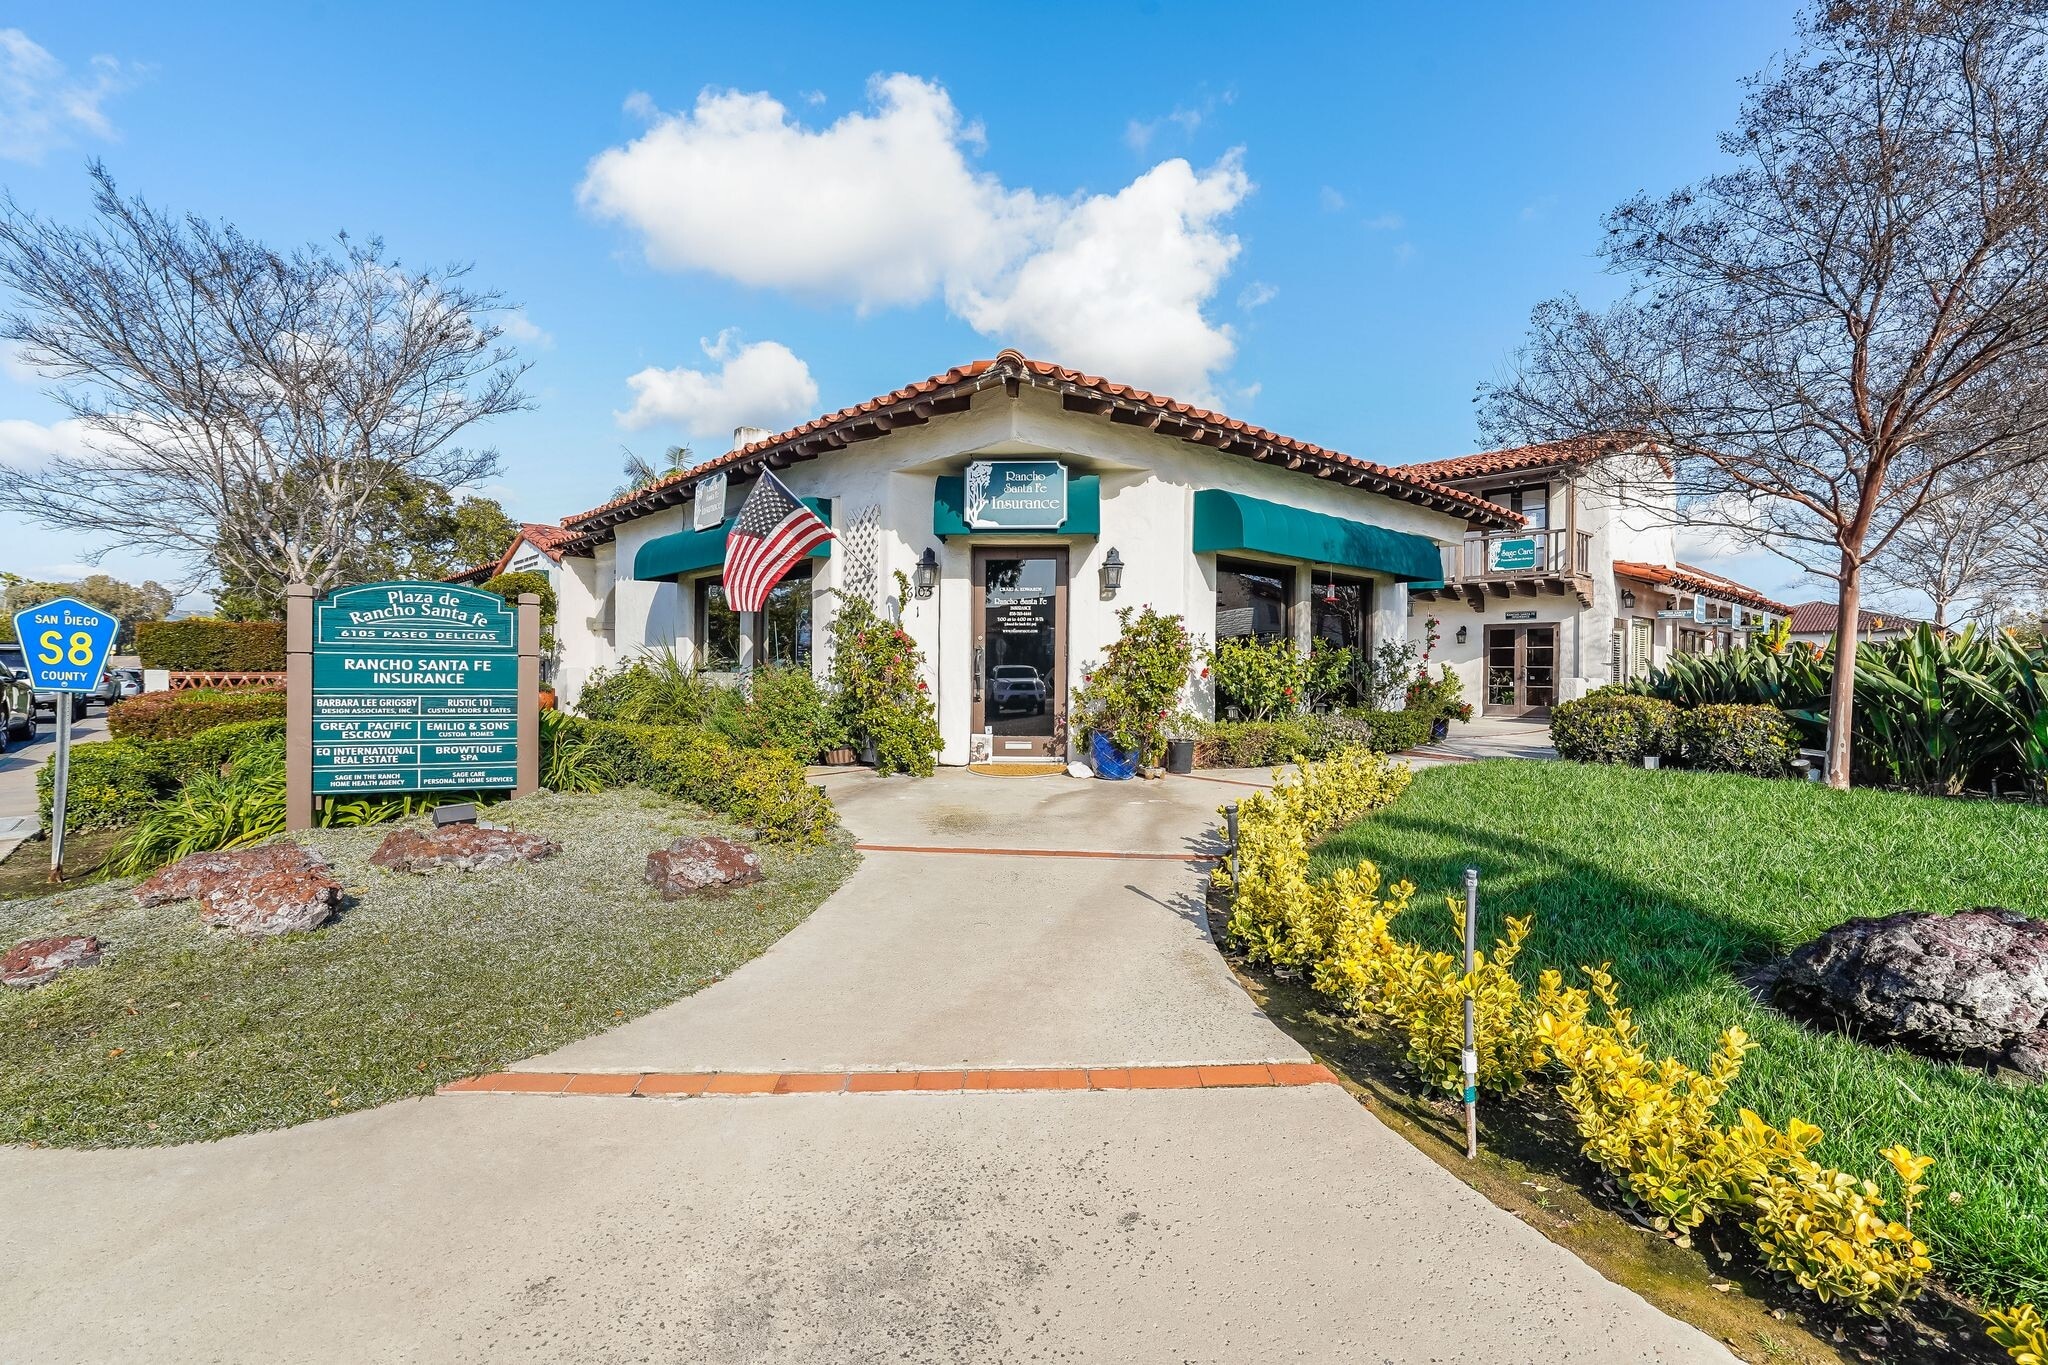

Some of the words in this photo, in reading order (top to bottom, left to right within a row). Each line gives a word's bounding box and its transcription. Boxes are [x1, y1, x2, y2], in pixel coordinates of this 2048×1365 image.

[1005, 470, 1046, 481] Rancho
[1003, 483, 1033, 493] Santa
[1035, 482, 1048, 493] Fe
[991, 495, 1060, 510] Insurance
[1517, 547, 1534, 556] Care
[387, 590, 433, 604] Plaza
[439, 592, 460, 607] de
[1019, 597, 1038, 605] Santa
[349, 603, 416, 625] Rancho
[421, 603, 467, 622] Santa
[472, 612, 488, 627] fe
[35, 614, 59, 625] SAN
[64, 616, 99, 627] DIEGO
[383, 631, 428, 639] PASEO
[435, 632, 496, 640] DELICIAS
[38, 630, 93, 666] S8
[344, 659, 413, 671] RANCHO
[418, 659, 469, 671] SANTA
[474, 660, 492, 671] FE
[41, 670, 88, 681] COUNTY
[373, 672, 465, 684] INSURANCE
[316, 698, 359, 707] BARBARA
[361, 698, 378, 707] LEE
[379, 698, 417, 707] GRIGSBY
[447, 699, 477, 707] RUSTIC
[479, 699, 493, 707] 101
[320, 722, 361, 730] GREAT
[367, 722, 412, 730] PACIFIC
[426, 722, 465, 731] EMILIO
[468, 722, 477, 731] &
[480, 722, 509, 730] SONS
[341, 731, 392, 739] ESCROW
[316, 748, 330, 756] EQ
[333, 747, 415, 756] INTERNATIONAL
[435, 745, 503, 754] BROWTIQUE
[333, 756, 360, 764] REAL
[362, 755, 399, 763] ESTATE
